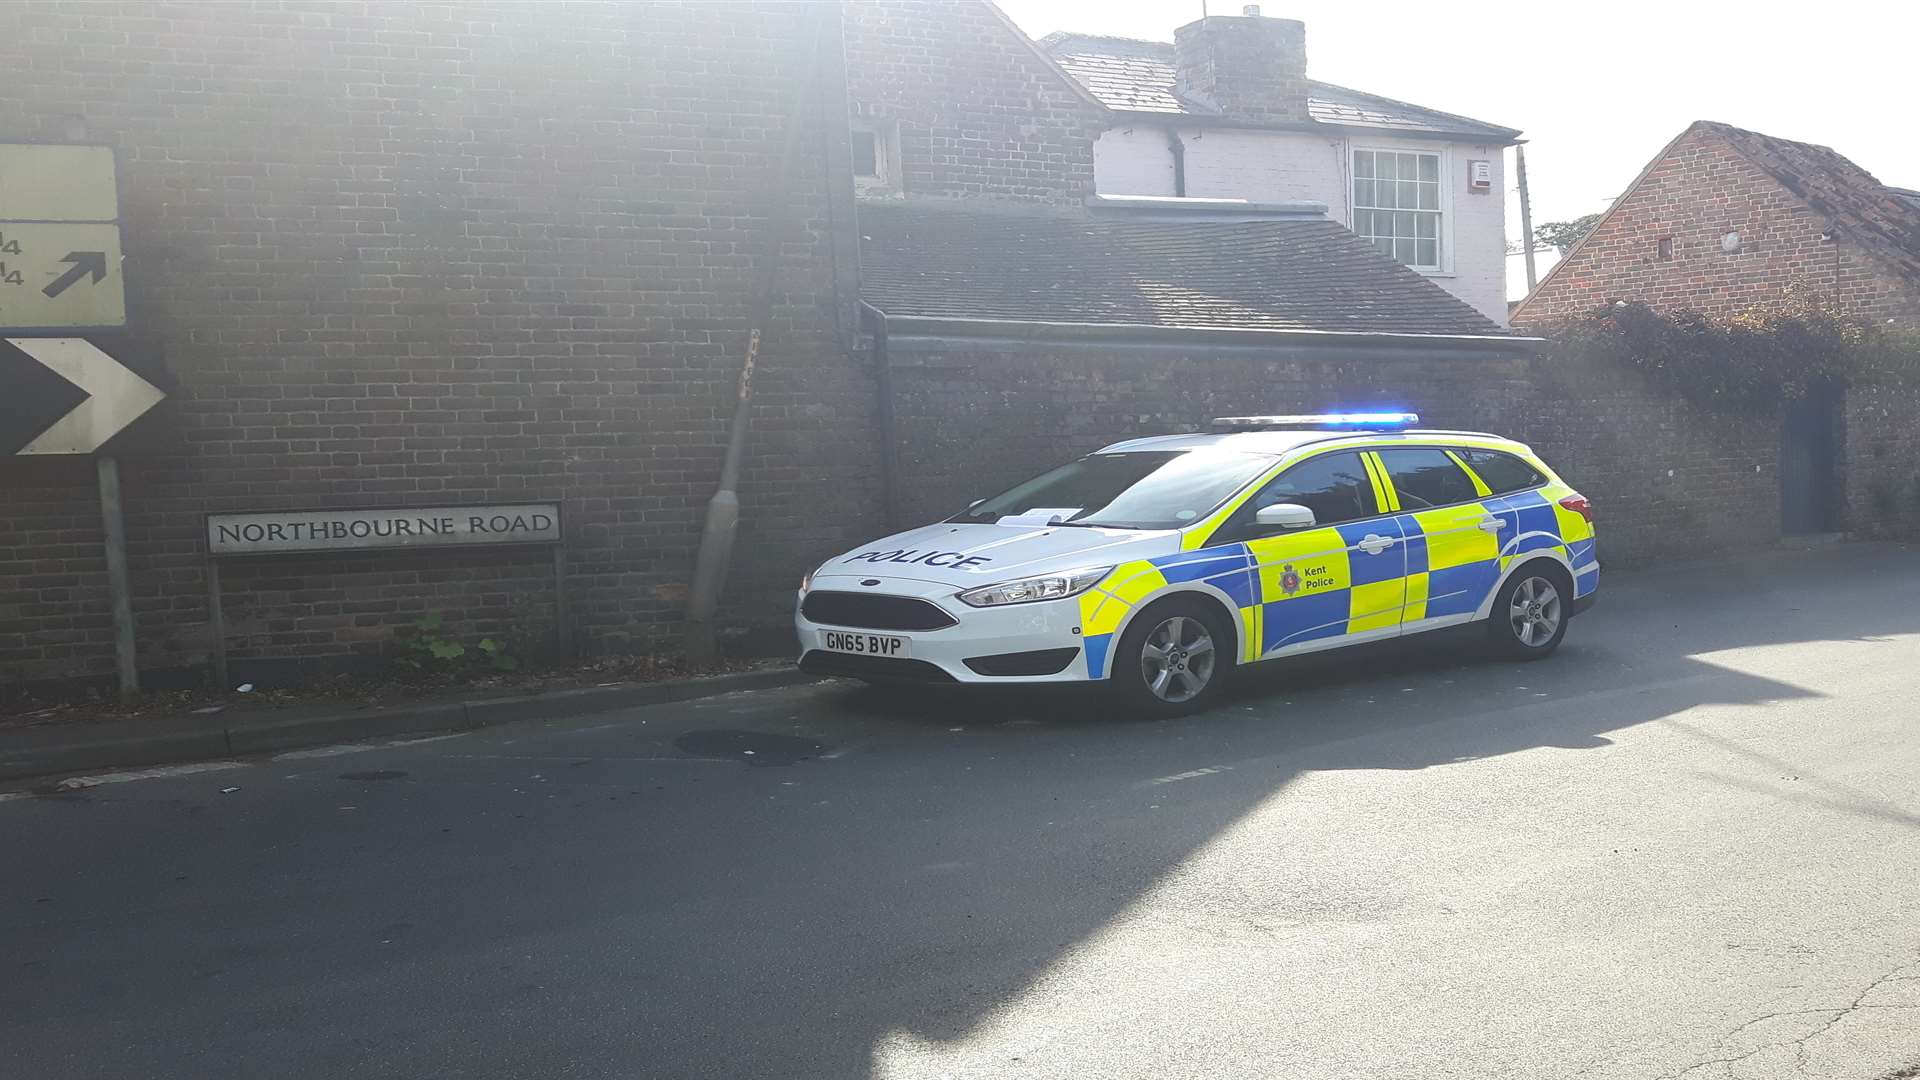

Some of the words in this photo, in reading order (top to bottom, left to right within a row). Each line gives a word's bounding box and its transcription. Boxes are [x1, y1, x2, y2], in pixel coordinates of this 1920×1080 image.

[217, 517, 455, 543] NORTHBOURNE
[468, 514, 551, 533] ROAD
[842, 549, 992, 571] POLICE
[1304, 566, 1327, 576] Kent
[1306, 578, 1334, 589] Police
[826, 632, 864, 651] GN65
[869, 636, 901, 655] BVP
